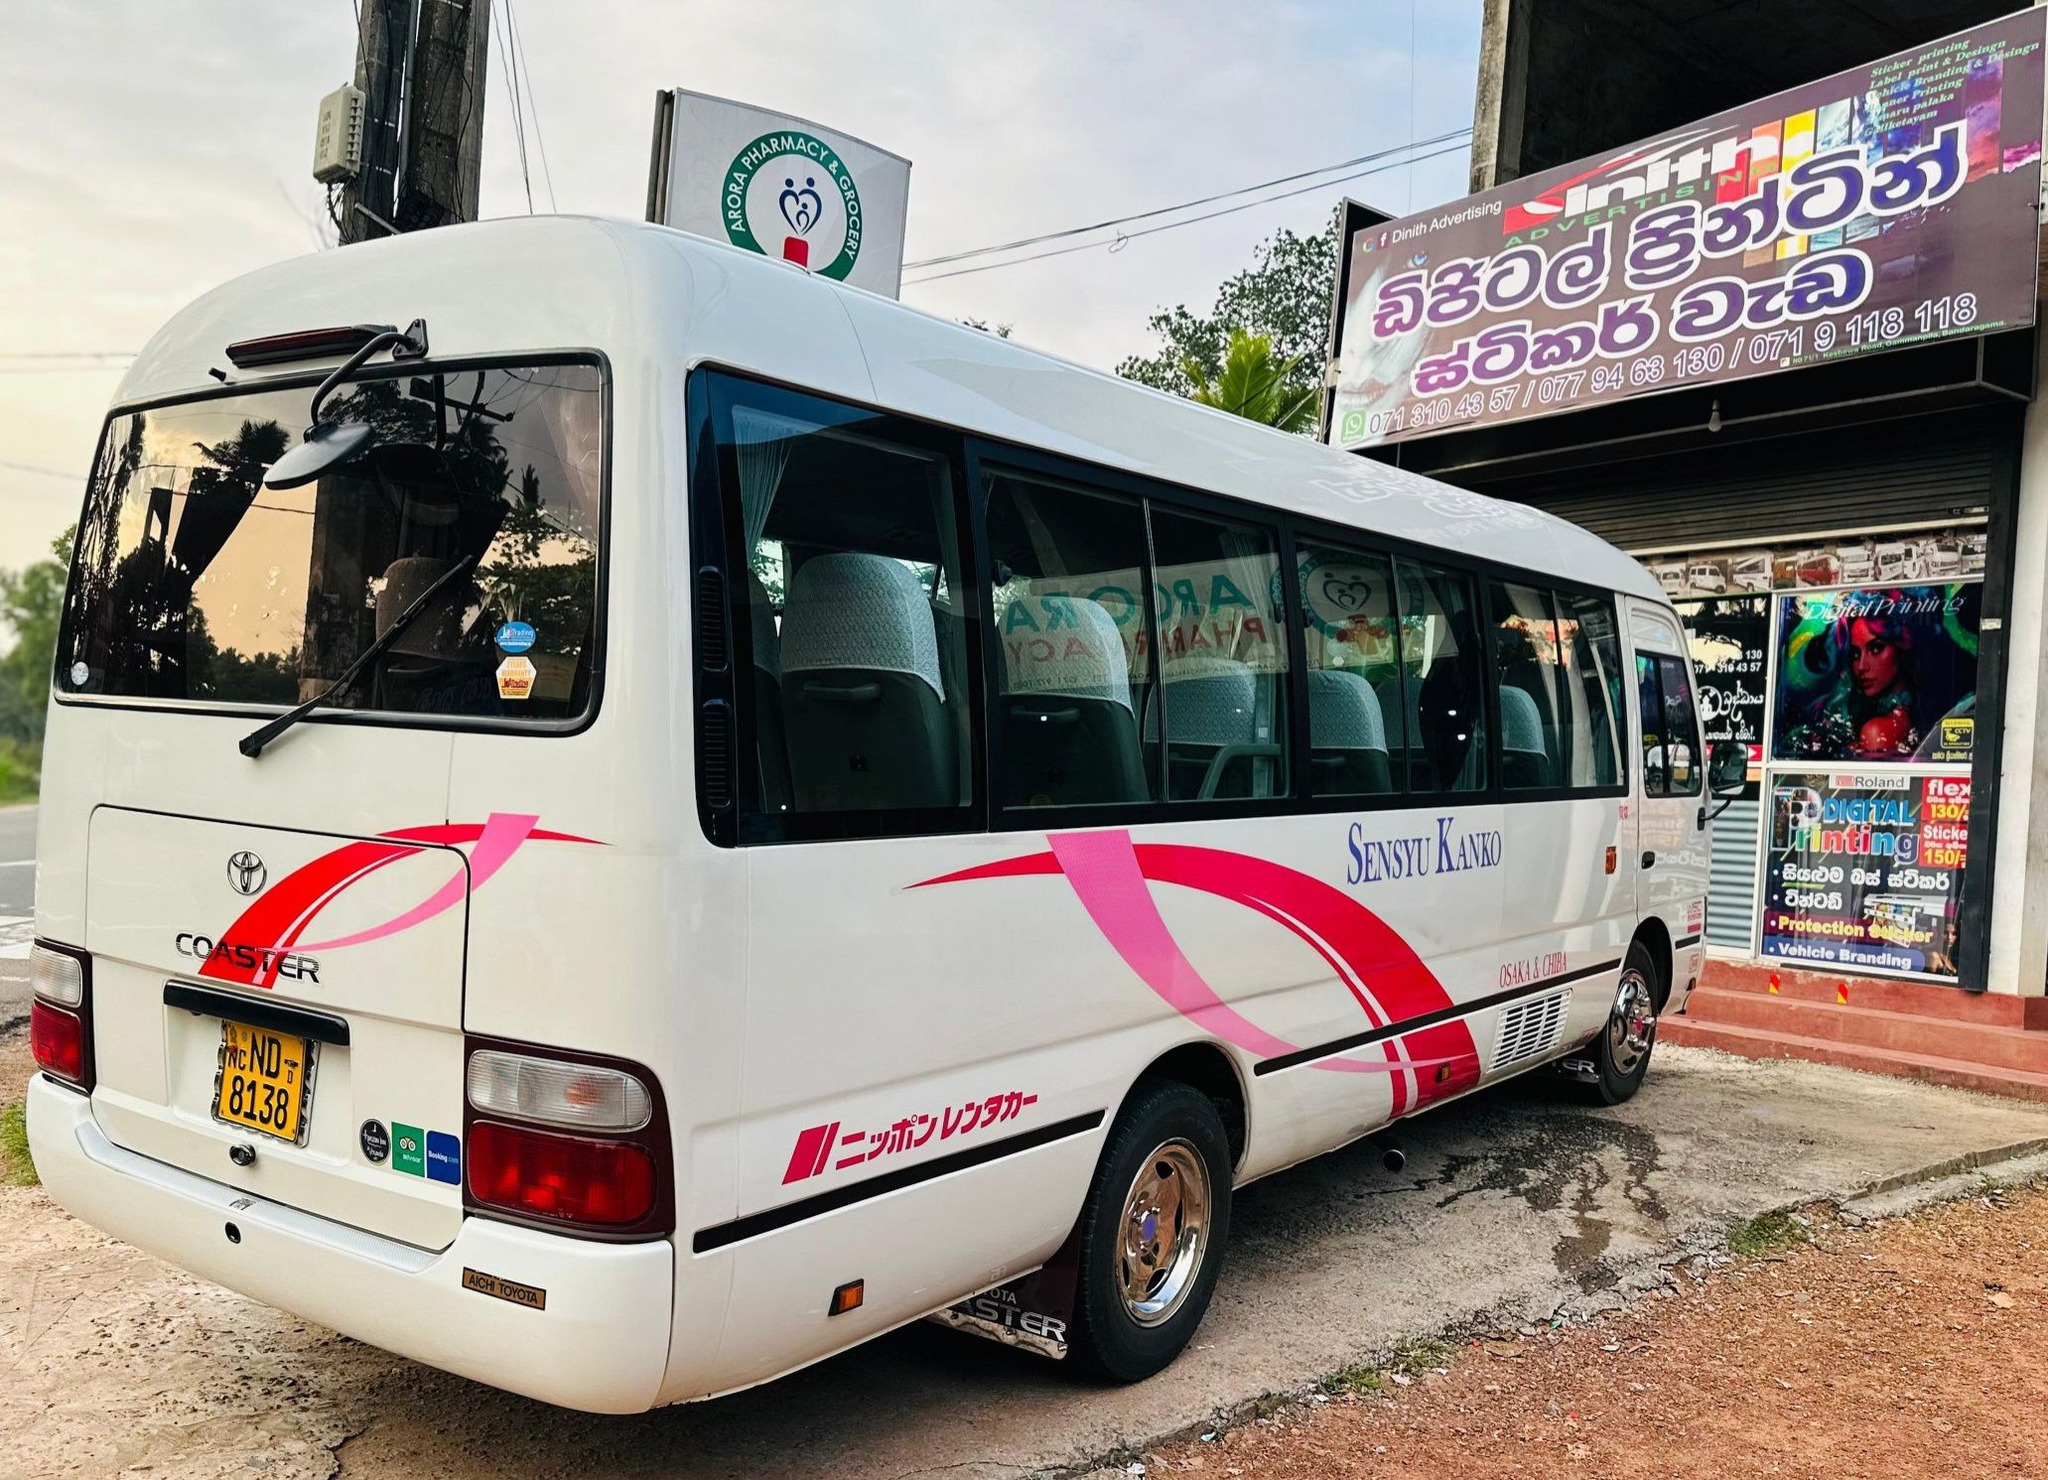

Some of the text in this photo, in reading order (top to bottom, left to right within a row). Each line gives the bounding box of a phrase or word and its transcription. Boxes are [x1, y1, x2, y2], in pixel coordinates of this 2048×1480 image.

[1869, 74, 1902, 89] Label
[1908, 62, 1940, 79] print
[1942, 57, 1952, 66] &
[1871, 39, 1971, 78] Sticker printing
[1913, 64, 1971, 87] Branding
[1973, 58, 1984, 68] &
[1912, 78, 1964, 99] Printing
[727, 135, 861, 261] ARORA PHARMACY & GROCERY
[1392, 222, 1428, 244] Dinith
[1429, 200, 1502, 232] Advertising
[1669, 249, 1874, 343] වැඩ
[1369, 407, 1405, 434] 071
[1410, 399, 1451, 428] 310
[1456, 392, 1484, 419] 43
[1488, 384, 1521, 414] 57
[1537, 371, 1586, 403] 077
[1590, 363, 1624, 394] 94
[1629, 357, 1664, 387] 63
[1673, 344, 1725, 377] 130
[1749, 326, 1804, 364] 071
[1814, 321, 1836, 351] 9
[1845, 307, 1904, 346] 118
[1914, 292, 1978, 331] 118
[1806, 596, 1965, 624] Digital Printing
[1736, 662, 1748, 672] 43
[1750, 662, 1762, 672] 57
[1746, 650, 1762, 660] 130
[1855, 776, 1905, 789] Roland
[1822, 797, 1917, 827] DIGITAL
[1778, 915, 1865, 938] Protection
[175, 933, 321, 984] COASTER
[1500, 951, 1567, 988] OSAKA & CHIBA
[1778, 942, 1912, 970] Vehicle Branding
[249, 1032, 281, 1079] ND
[229, 1075, 289, 1130] 8138
[469, 1275, 538, 1304] AICHI TOYOTA
